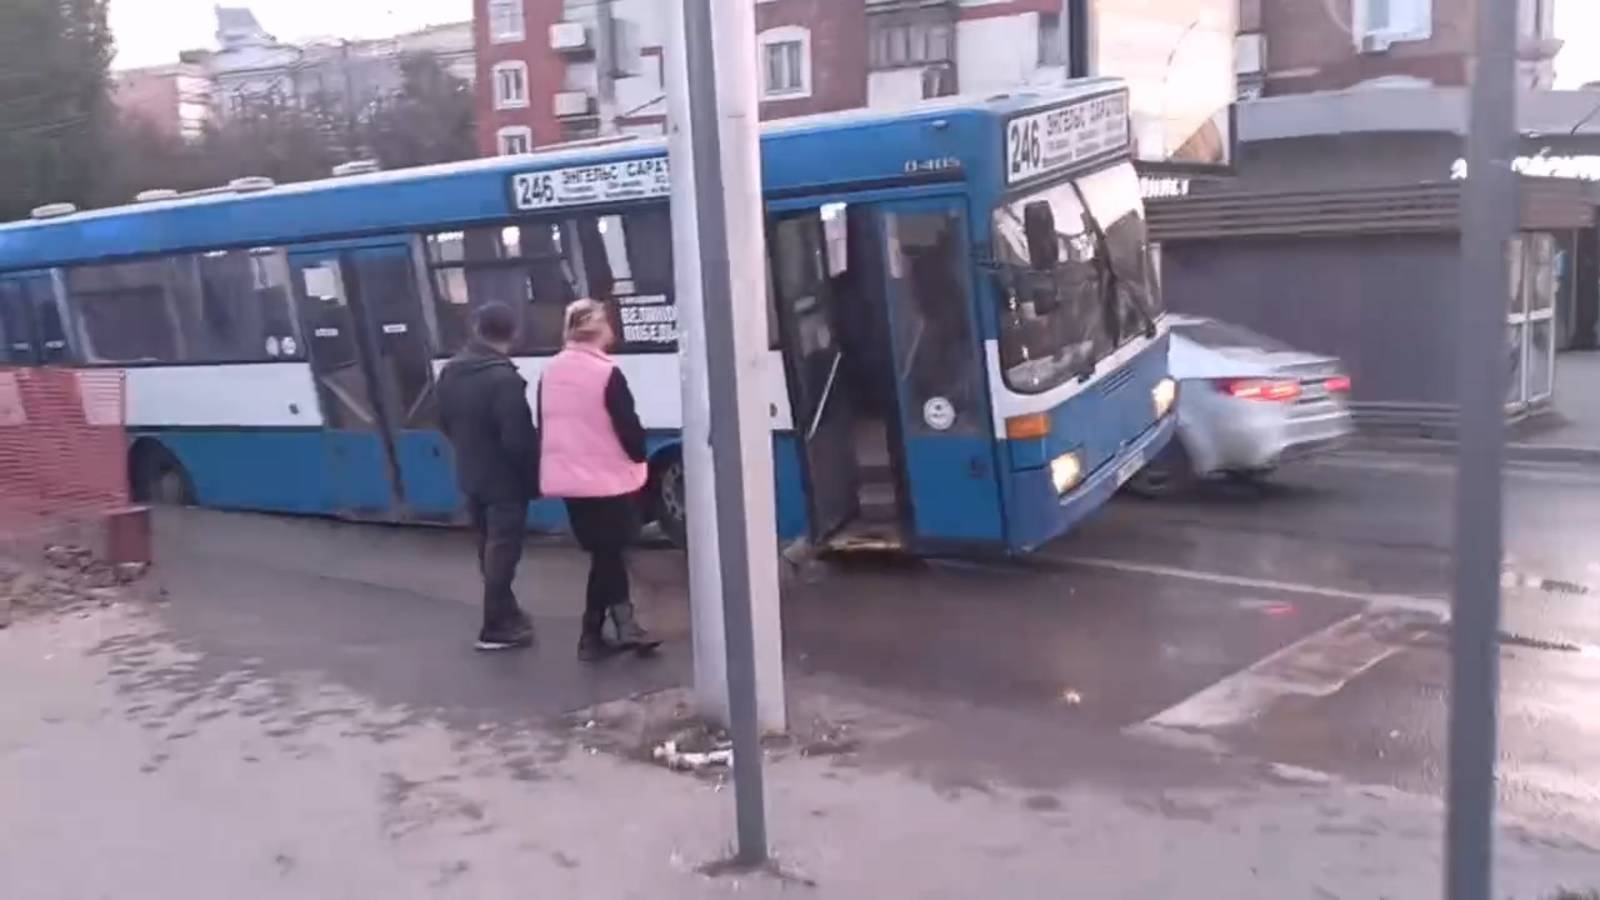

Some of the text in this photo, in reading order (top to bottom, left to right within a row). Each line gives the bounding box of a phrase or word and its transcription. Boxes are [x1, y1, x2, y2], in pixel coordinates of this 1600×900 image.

[1011, 119, 1040, 173] 246
[519, 174, 555, 205] 246
[561, 165, 618, 185] ЭНГЕЛЬС
